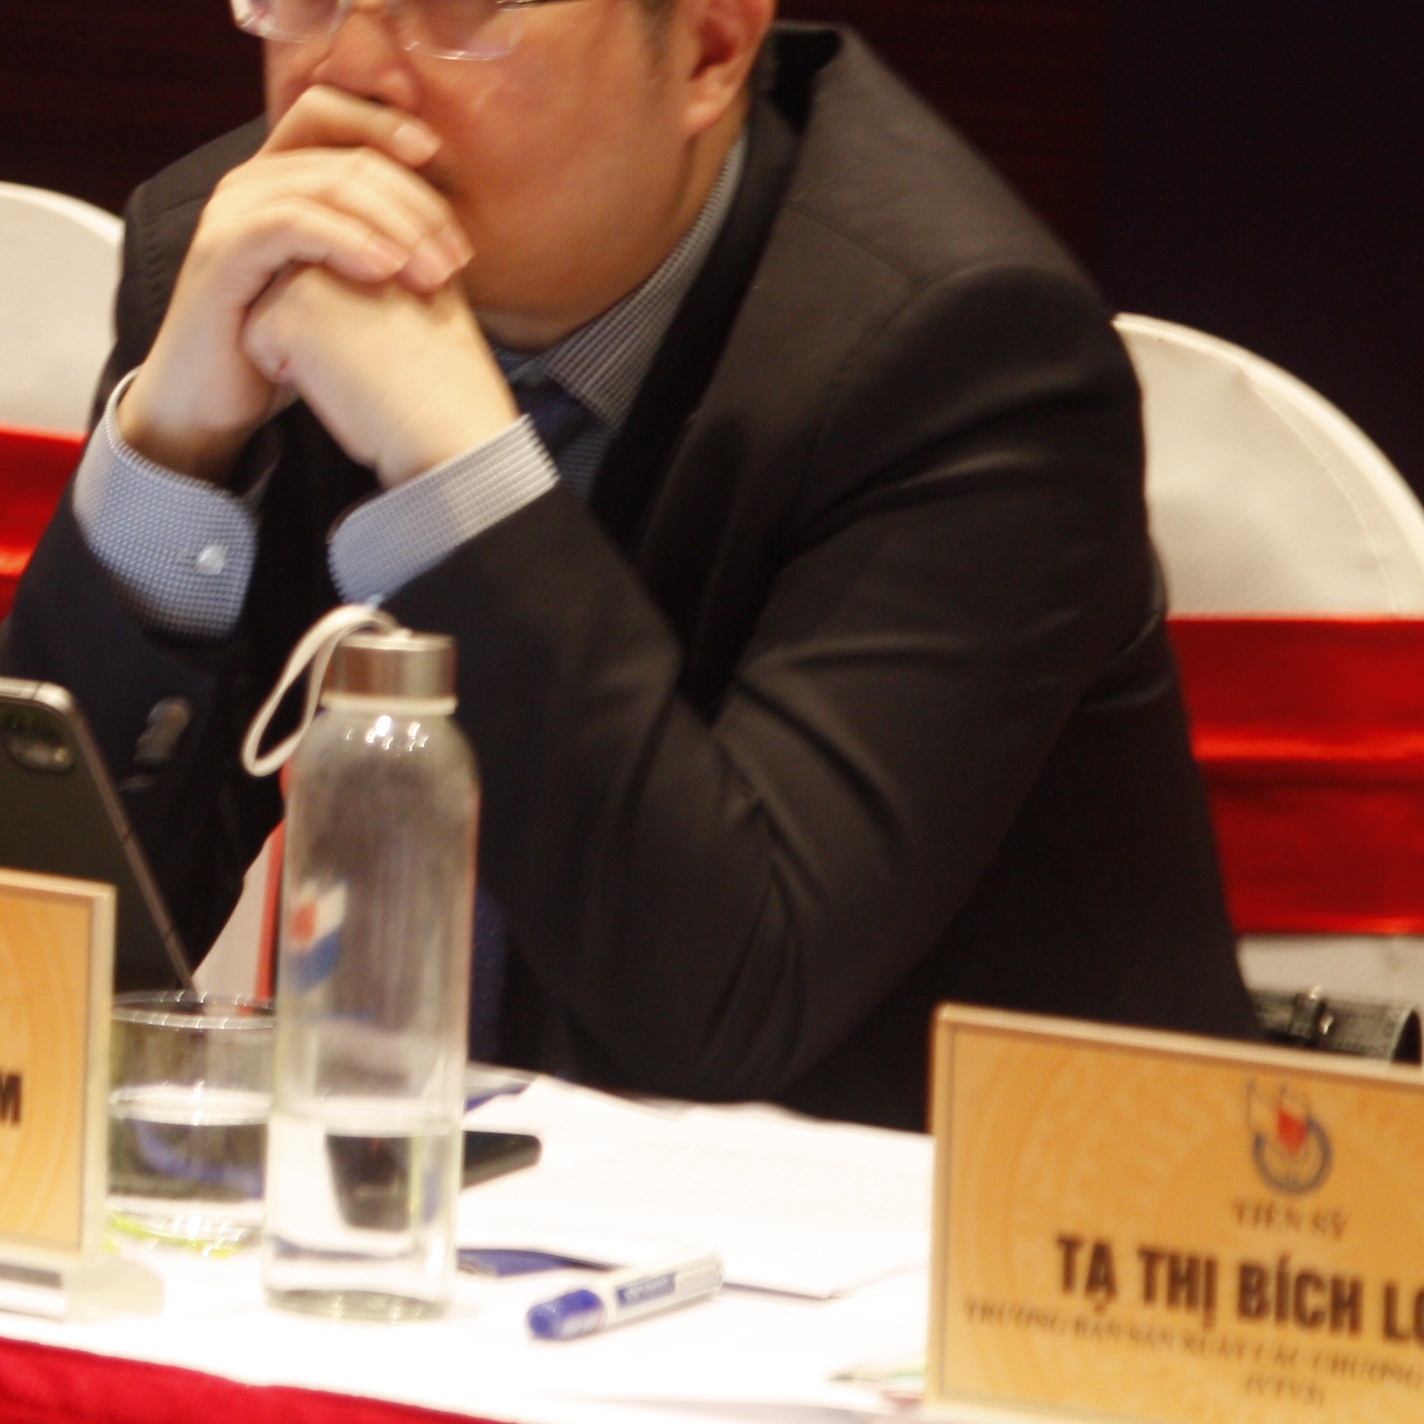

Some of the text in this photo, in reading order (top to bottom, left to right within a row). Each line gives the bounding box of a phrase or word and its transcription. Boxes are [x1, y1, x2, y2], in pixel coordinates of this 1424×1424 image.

[1055, 1230, 1118, 1314] TẠ
[1136, 1242, 1218, 1332] THỊ
[1236, 1249, 1363, 1338] BÍCH
